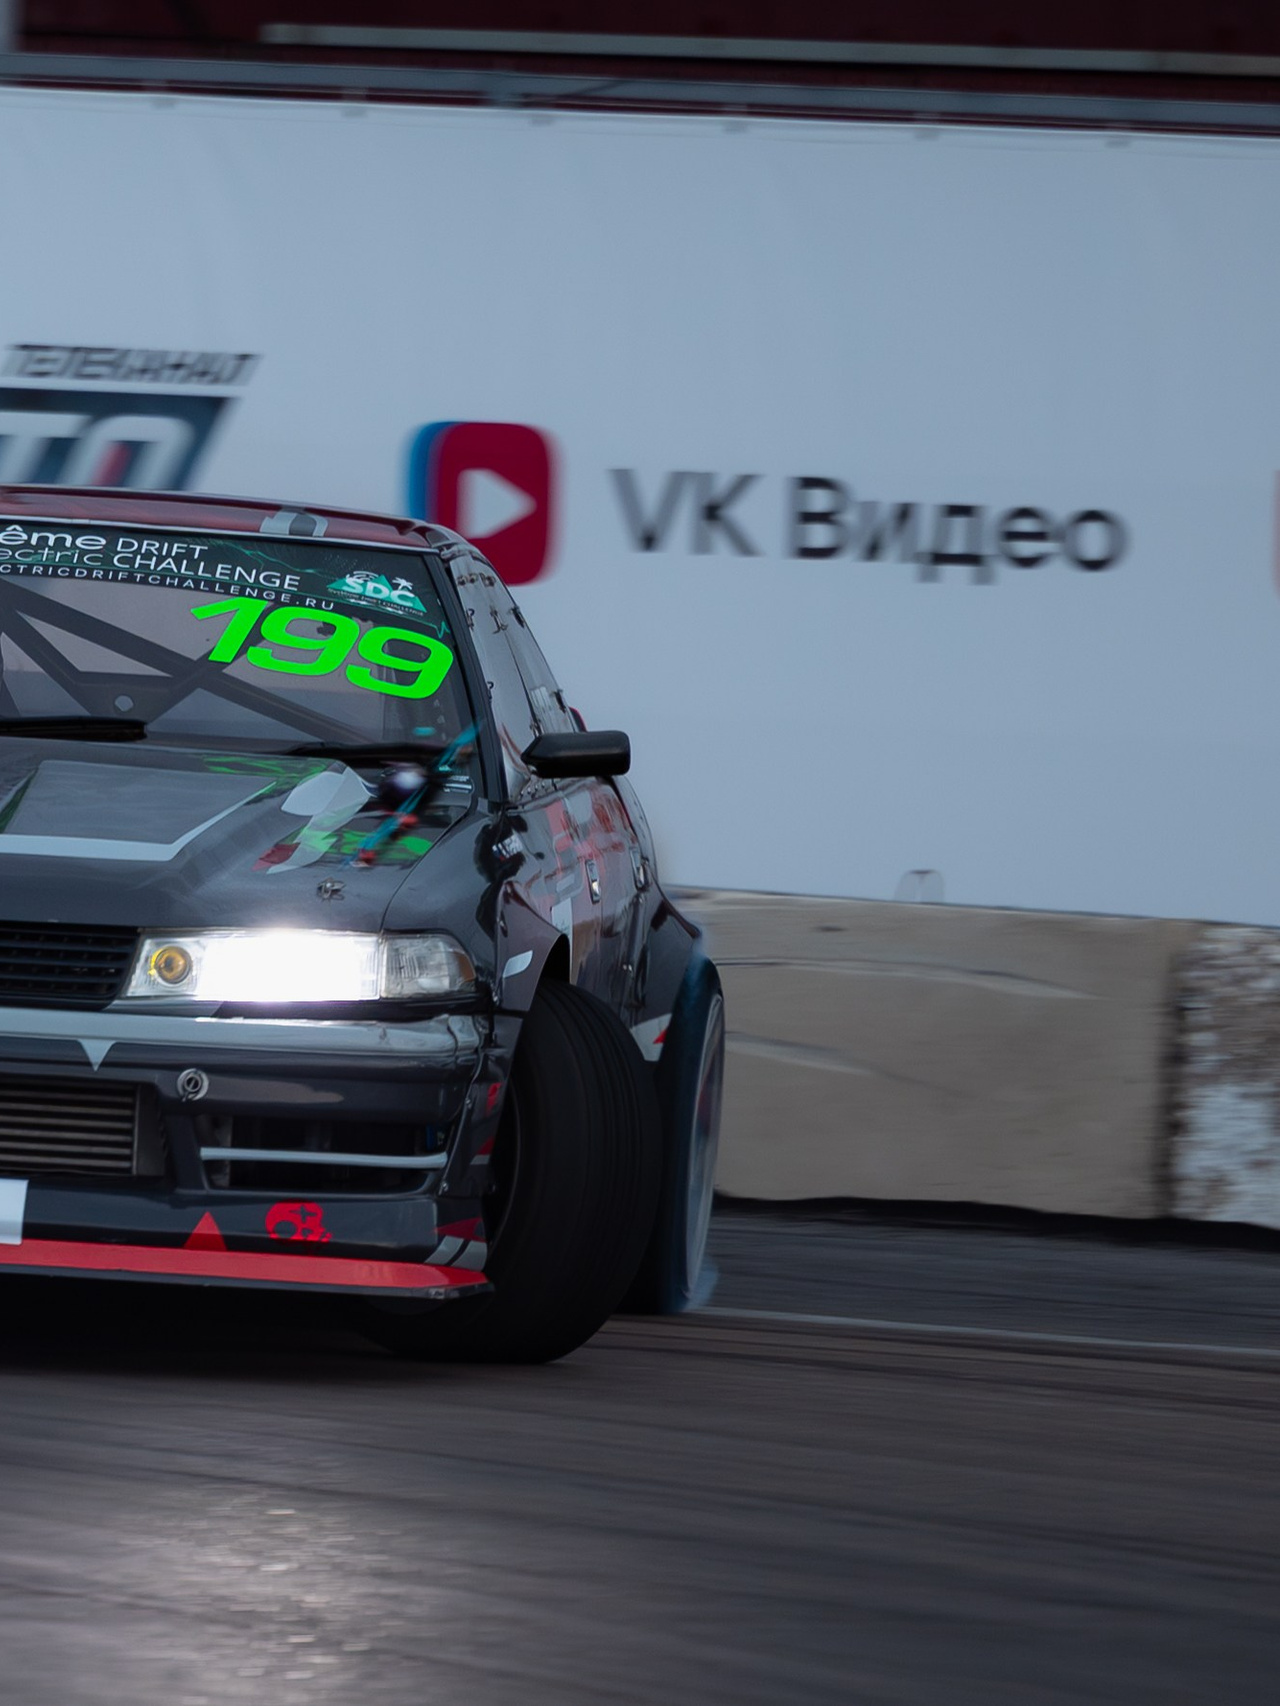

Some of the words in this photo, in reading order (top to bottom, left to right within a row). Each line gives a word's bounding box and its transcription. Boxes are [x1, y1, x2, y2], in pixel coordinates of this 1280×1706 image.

[606, 468, 765, 559] VK
[786, 476, 1130, 586] Видео
[117, 537, 208, 559] DRIFT
[113, 553, 301, 591] CHALLENGE
[342, 576, 415, 607] SDC
[190, 596, 454, 699] 199
